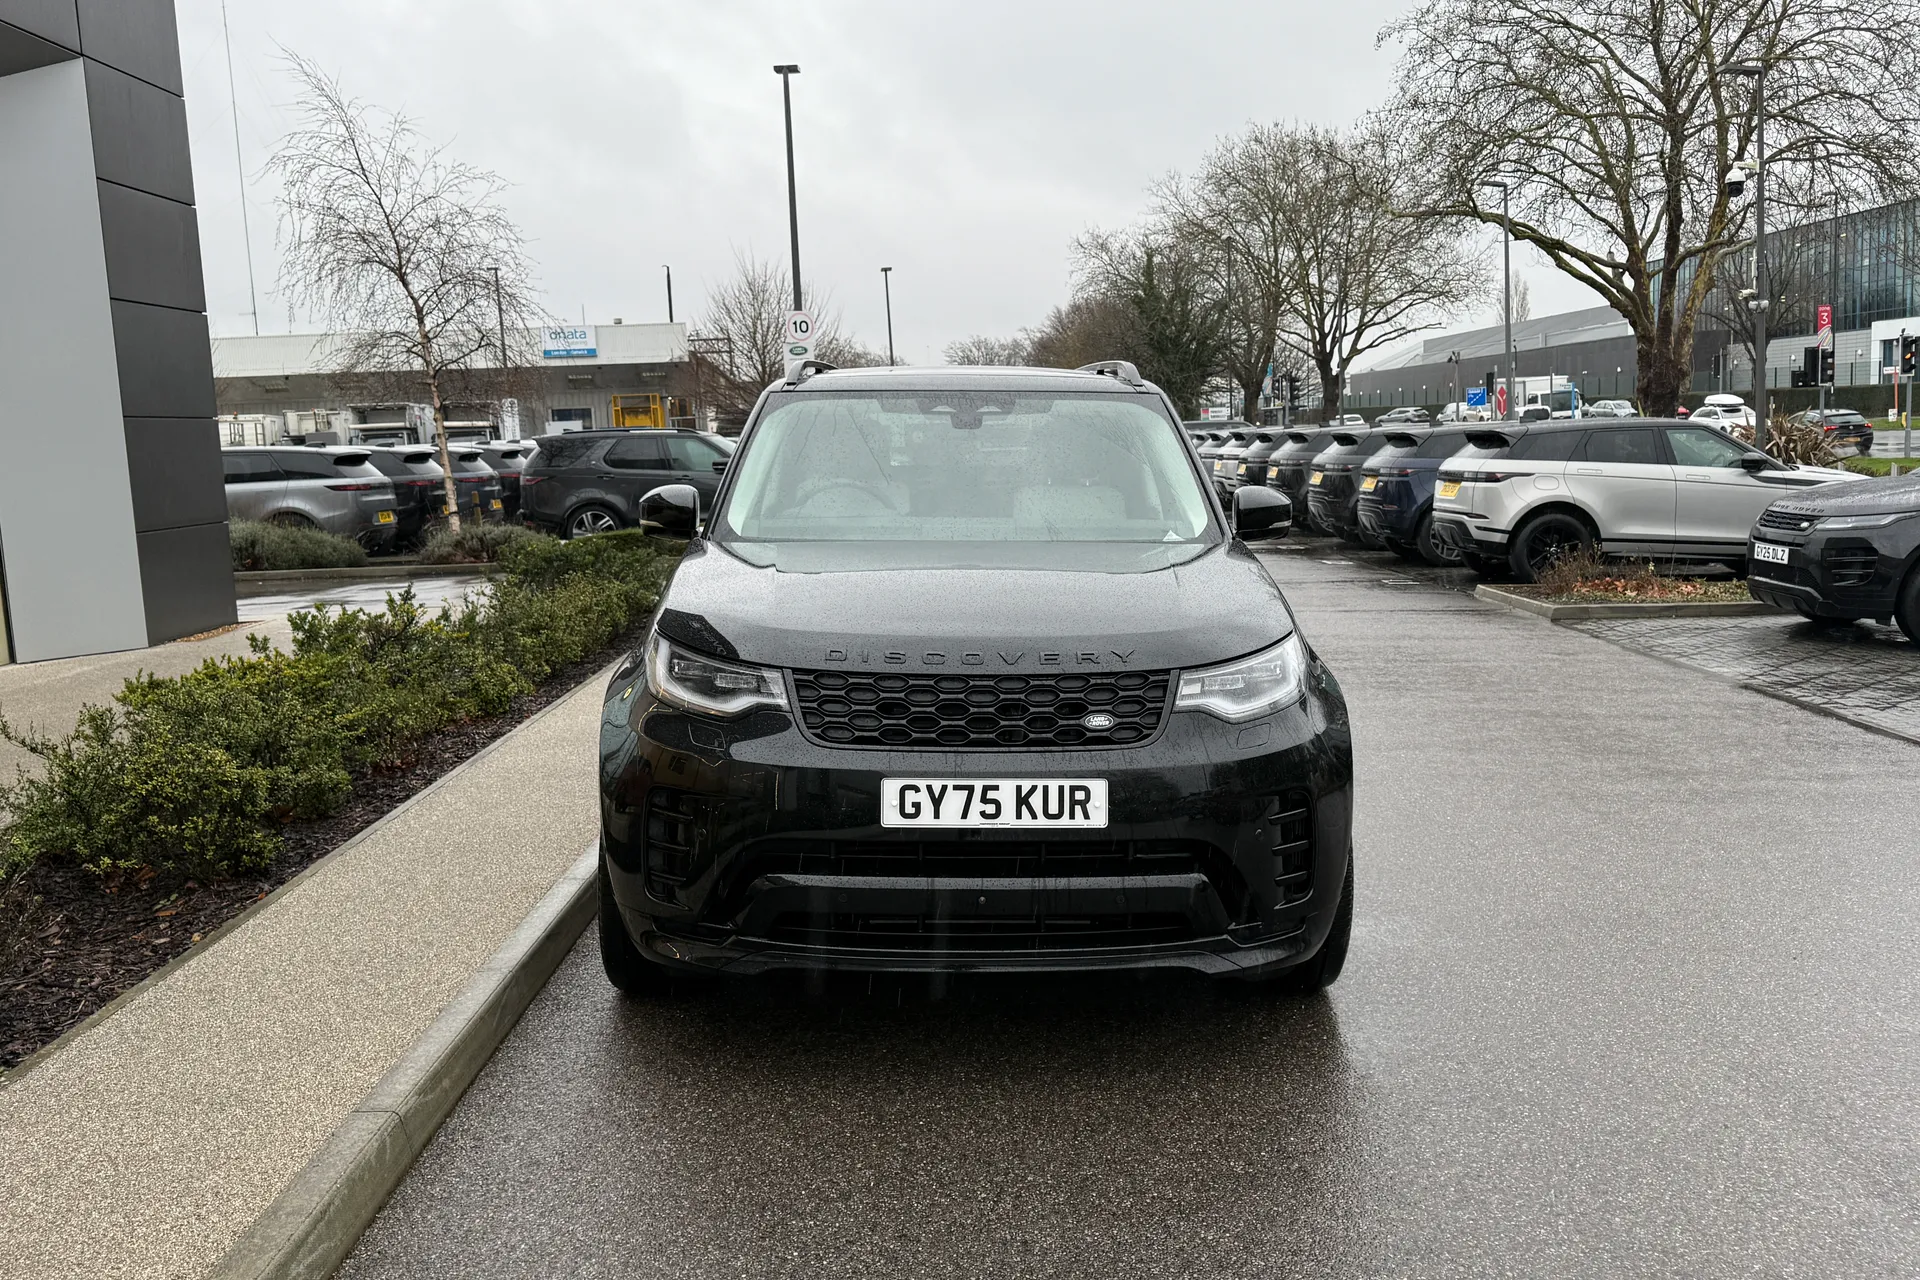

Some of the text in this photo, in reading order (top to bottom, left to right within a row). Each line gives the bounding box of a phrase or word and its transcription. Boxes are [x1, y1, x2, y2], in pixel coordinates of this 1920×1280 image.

[1820, 312, 1828, 324] 3
[792, 320, 809, 333] 10
[1772, 548, 1786, 562] DLZ
[825, 649, 1135, 666] DISCOVERY
[898, 783, 1092, 820] GY75 KUR
